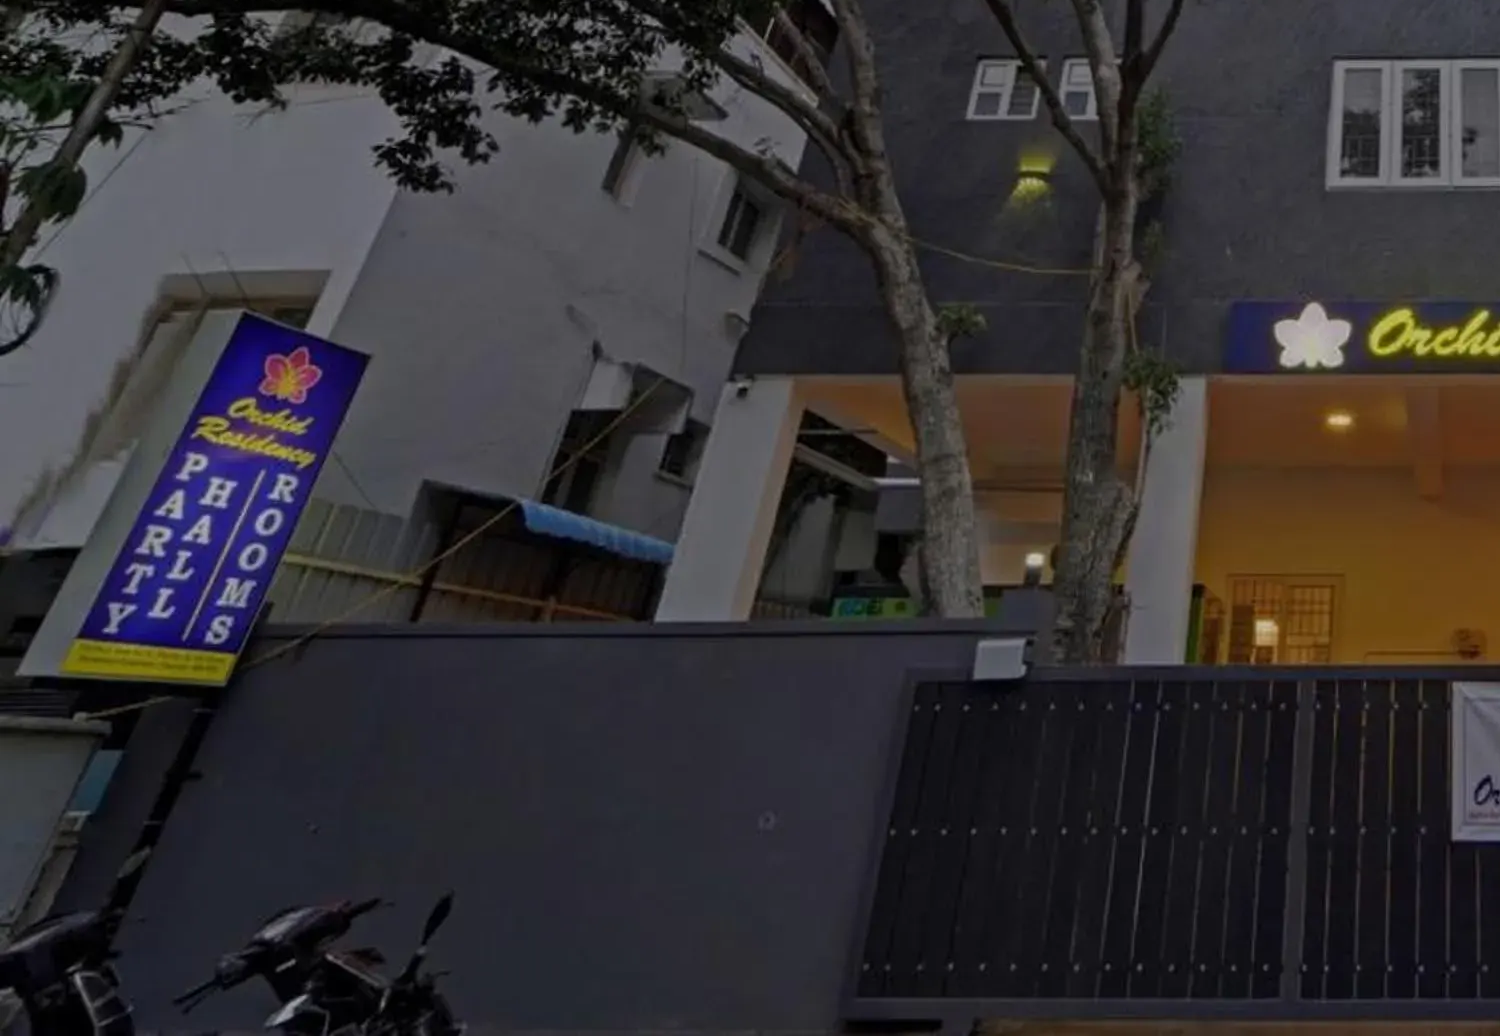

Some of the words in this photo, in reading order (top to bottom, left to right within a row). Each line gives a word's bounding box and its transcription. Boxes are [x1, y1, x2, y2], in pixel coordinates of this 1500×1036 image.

[192, 416, 317, 469] Residency
[227, 397, 314, 435] Orchid
[102, 452, 209, 634] PARTY
[148, 477, 238, 619] HALL
[205, 474, 299, 645] ROOMS
